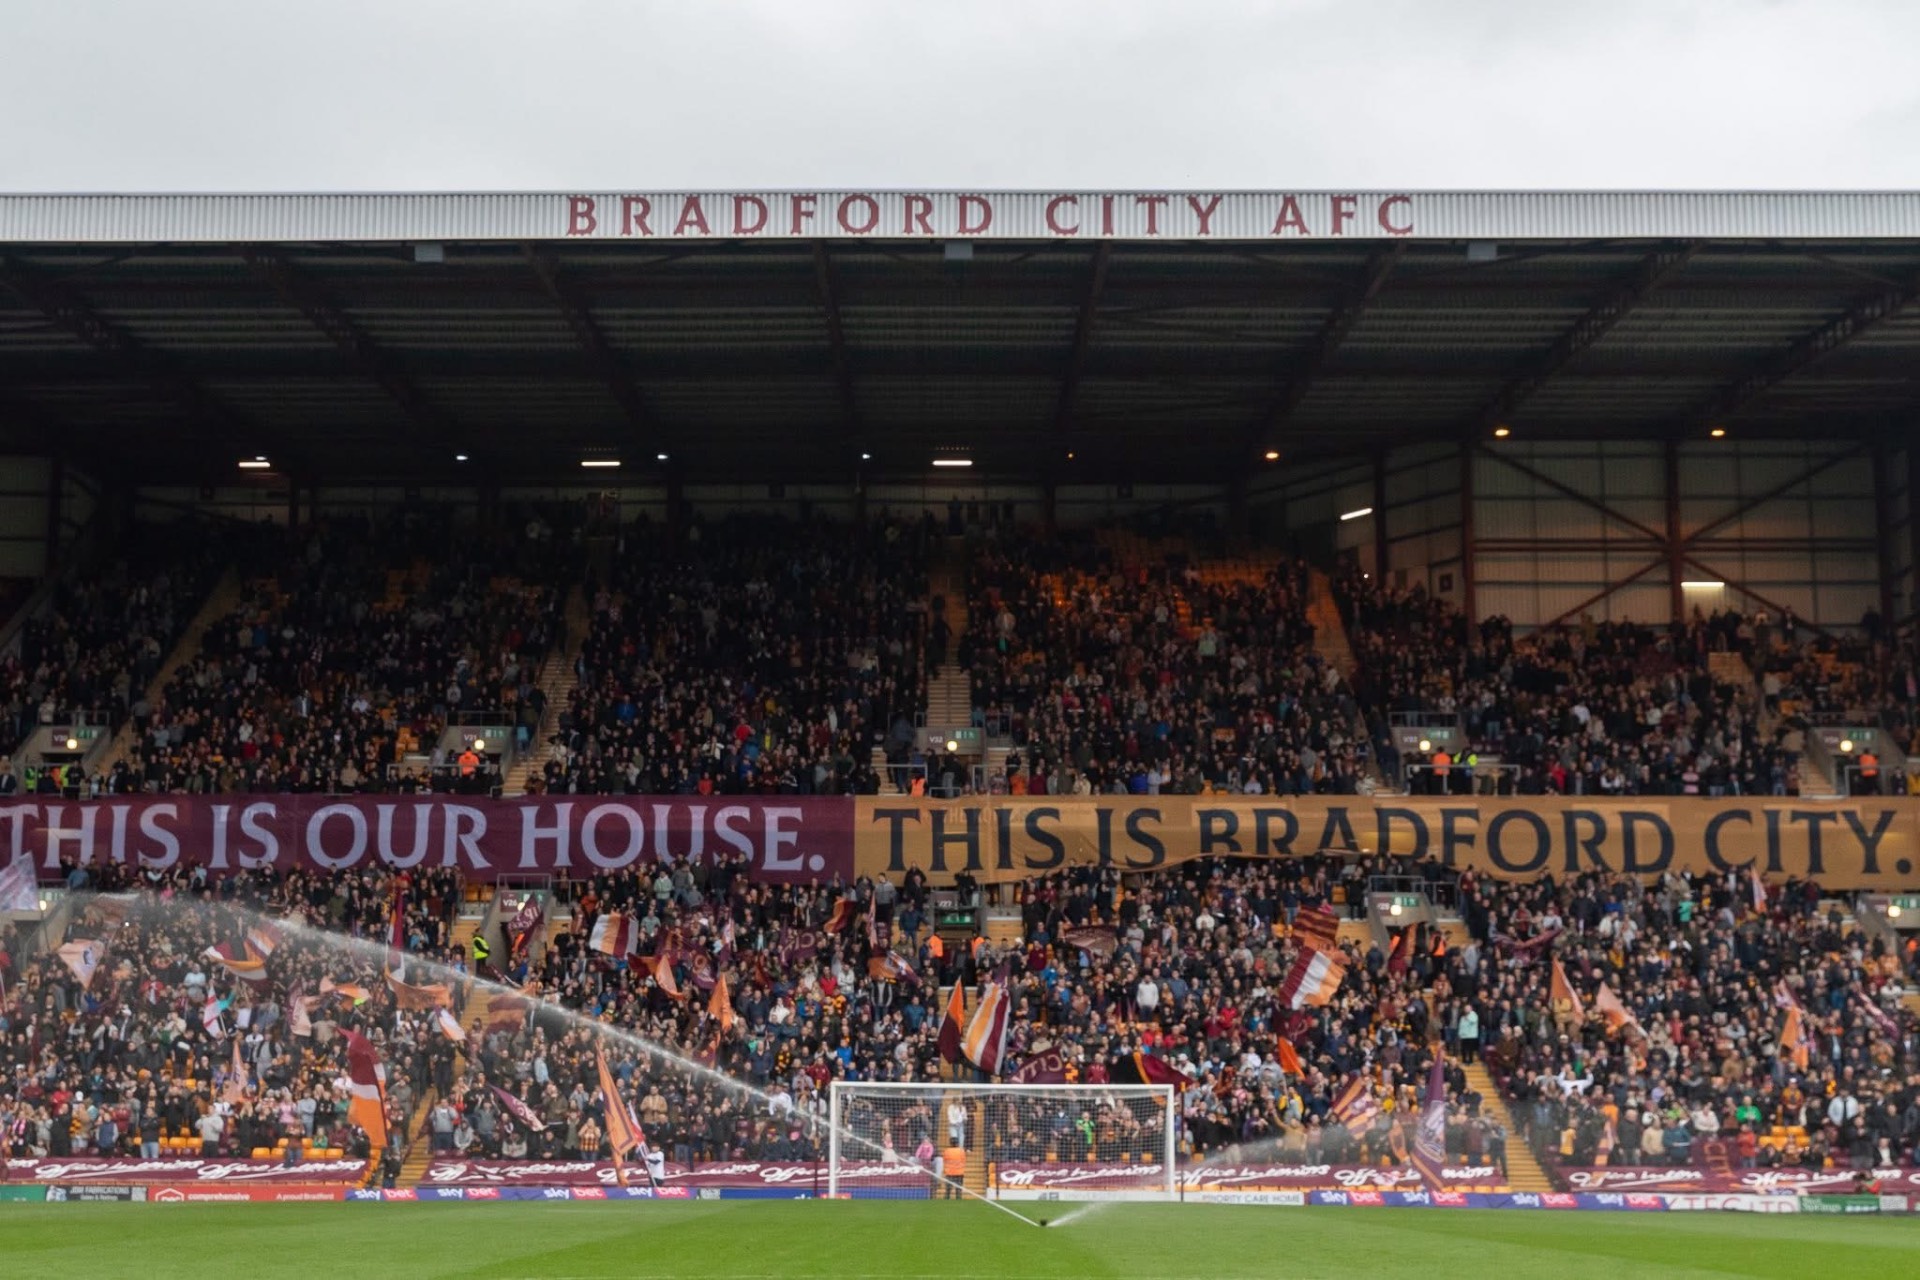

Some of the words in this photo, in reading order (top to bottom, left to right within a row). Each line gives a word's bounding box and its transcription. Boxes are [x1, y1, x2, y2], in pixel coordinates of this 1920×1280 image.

[566, 195, 993, 237] BRADFORD
[1045, 194, 1224, 237] CITY
[1271, 194, 1415, 238] AFC
[0, 803, 180, 868] THIS
[209, 803, 279, 868] IS
[305, 803, 493, 868] OUR
[518, 802, 825, 872] HOUSE.
[872, 807, 1065, 871] THIS
[1100, 807, 1166, 869] IS
[1196, 807, 1675, 874] BRADFORD
[1704, 809, 1913, 875] CITY.
[502, 899, 517, 907] V26
[188, 1193, 250, 1202] comprehensive
[354, 1189, 381, 1201] sky
[384, 1188, 414, 1199] bet
[437, 1188, 463, 1200] sky
[467, 1187, 494, 1198] bet
[543, 1188, 570, 1200] sky
[574, 1187, 602, 1198] bet
[626, 1187, 653, 1198] sky
[656, 1186, 685, 1196] bet
[1320, 1192, 1347, 1205] sky
[1351, 1190, 1380, 1202] bet
[1402, 1192, 1430, 1204] sky
[1433, 1191, 1462, 1202] bet
[1244, 1195, 1269, 1204] CARE
[1272, 1195, 1300, 1204] HOME
[1512, 1194, 1539, 1206] sky
[1543, 1192, 1574, 1204] bet
[1596, 1193, 1624, 1206] sky
[1626, 1193, 1658, 1205] bet
